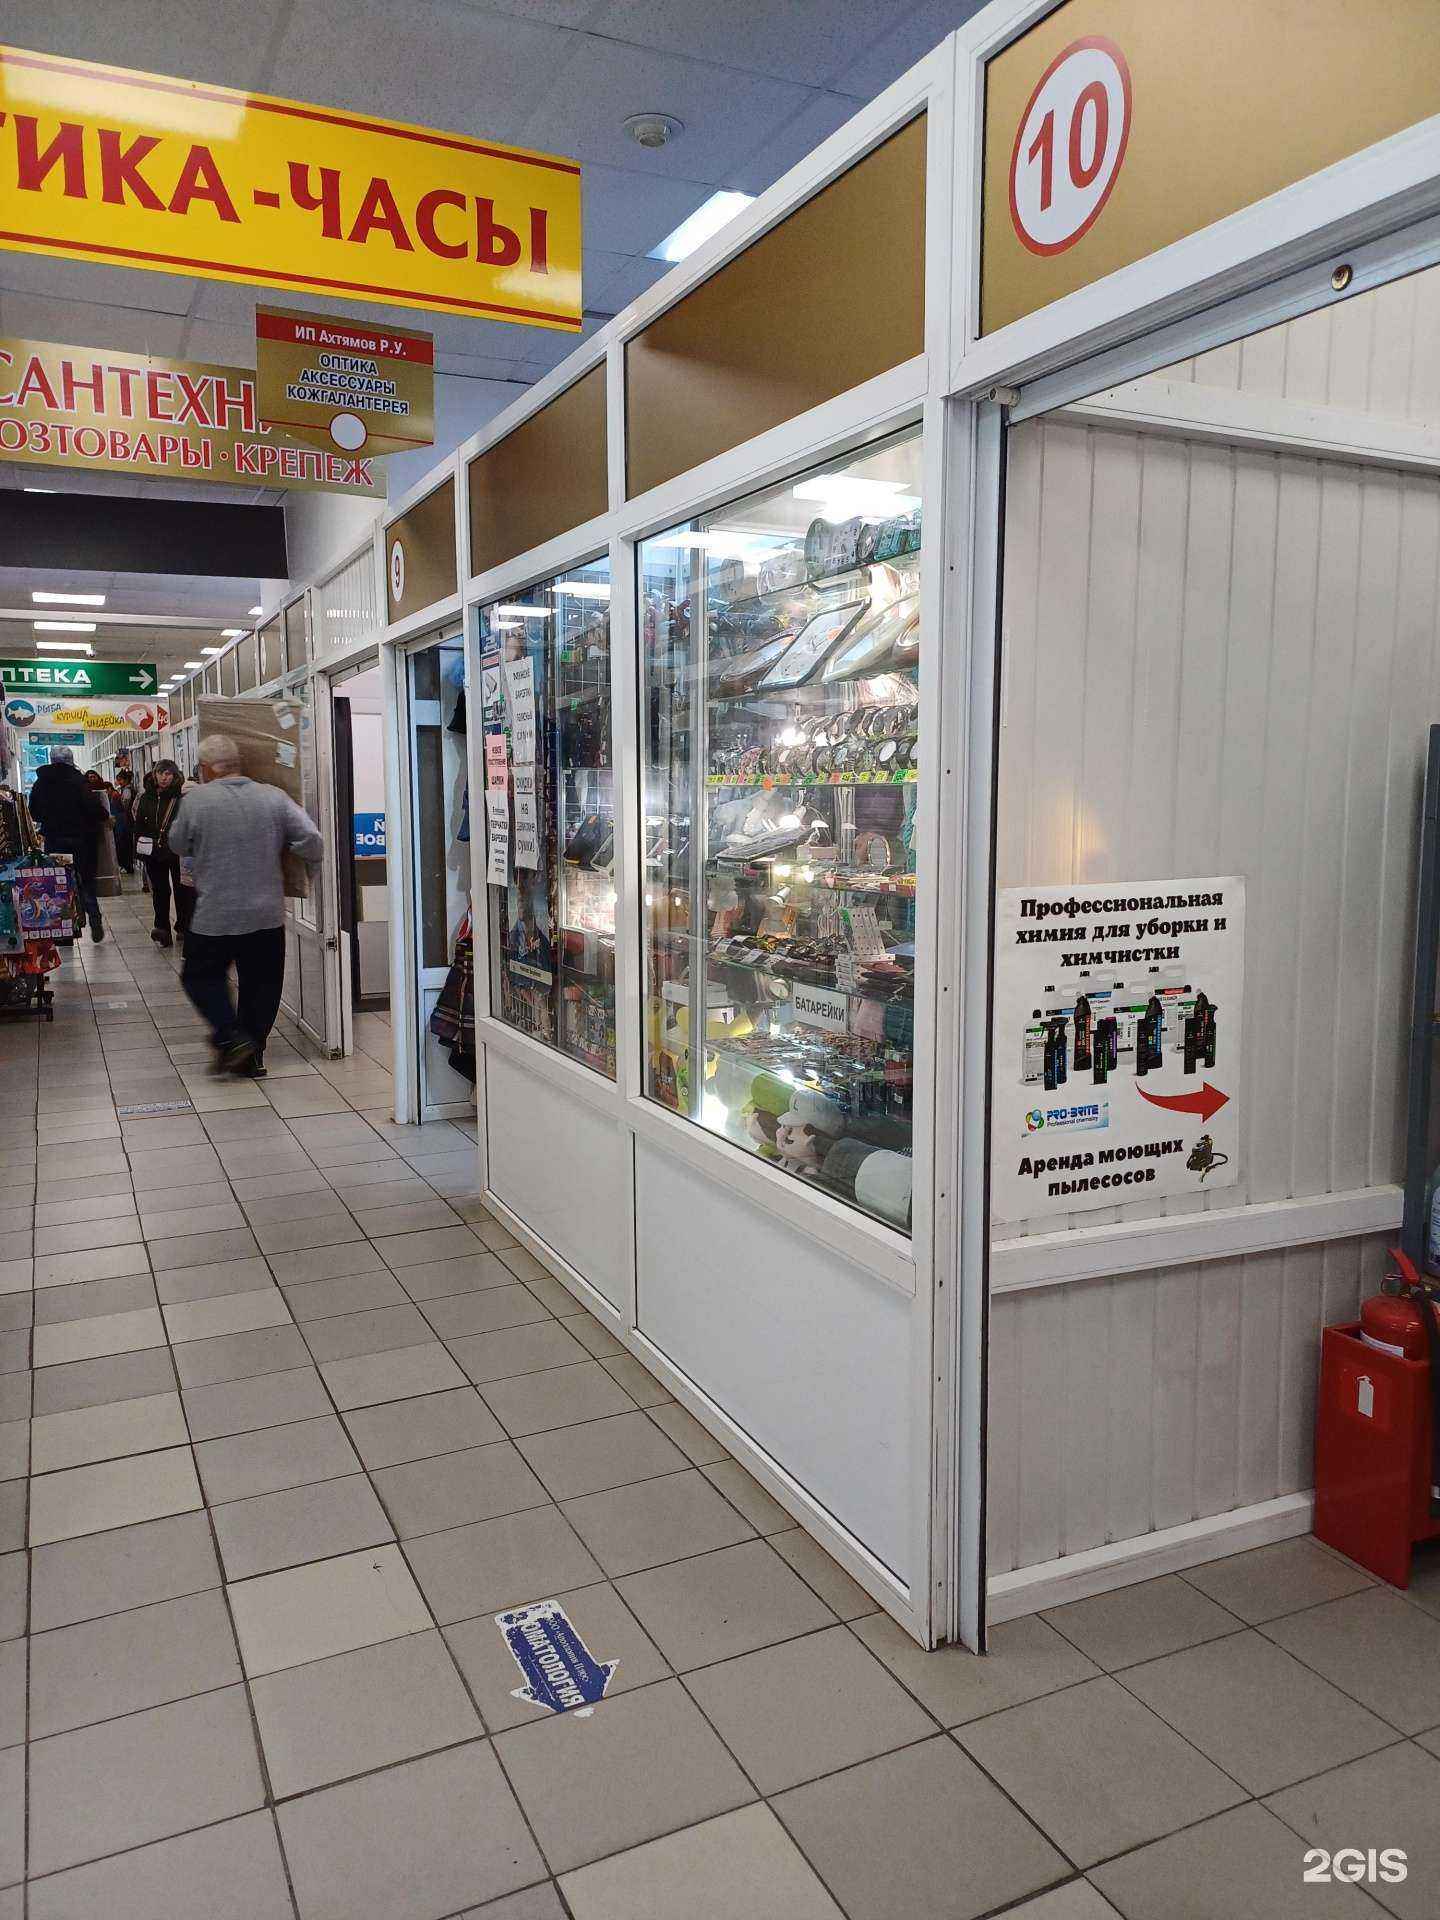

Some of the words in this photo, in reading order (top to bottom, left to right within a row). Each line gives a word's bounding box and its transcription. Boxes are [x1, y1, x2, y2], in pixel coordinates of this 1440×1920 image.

[1028, 80, 1109, 212] 10
[0, 111, 549, 275] ИКА-ЧАСЫ
[295, 325, 316, 342] ИП
[319, 330, 377, 351] Ахтямов
[380, 339, 407, 356] Р.У.
[319, 353, 379, 375] ОПТИКА
[0, 351, 272, 434] АНТЕХН
[300, 370, 396, 395] АКСЕССУАРЫ
[287, 384, 410, 415] КОЖГАЛАНТЕРЕЯ
[234, 442, 374, 487] КРЕПЕЖ
[1020, 892, 1223, 920] Профессиональная
[1016, 926, 1087, 945] химия
[1092, 925, 1131, 942] для
[1136, 919, 1209, 941] уборки
[1213, 918, 1227, 932] и
[1060, 946, 1180, 968] химчистки
[795, 996, 845, 1022] БАТАРЕЙКИ
[1018, 1153, 1095, 1178] Аренда
[1099, 1138, 1184, 1166] моющих
[1048, 1166, 1156, 1197] пылесосов
